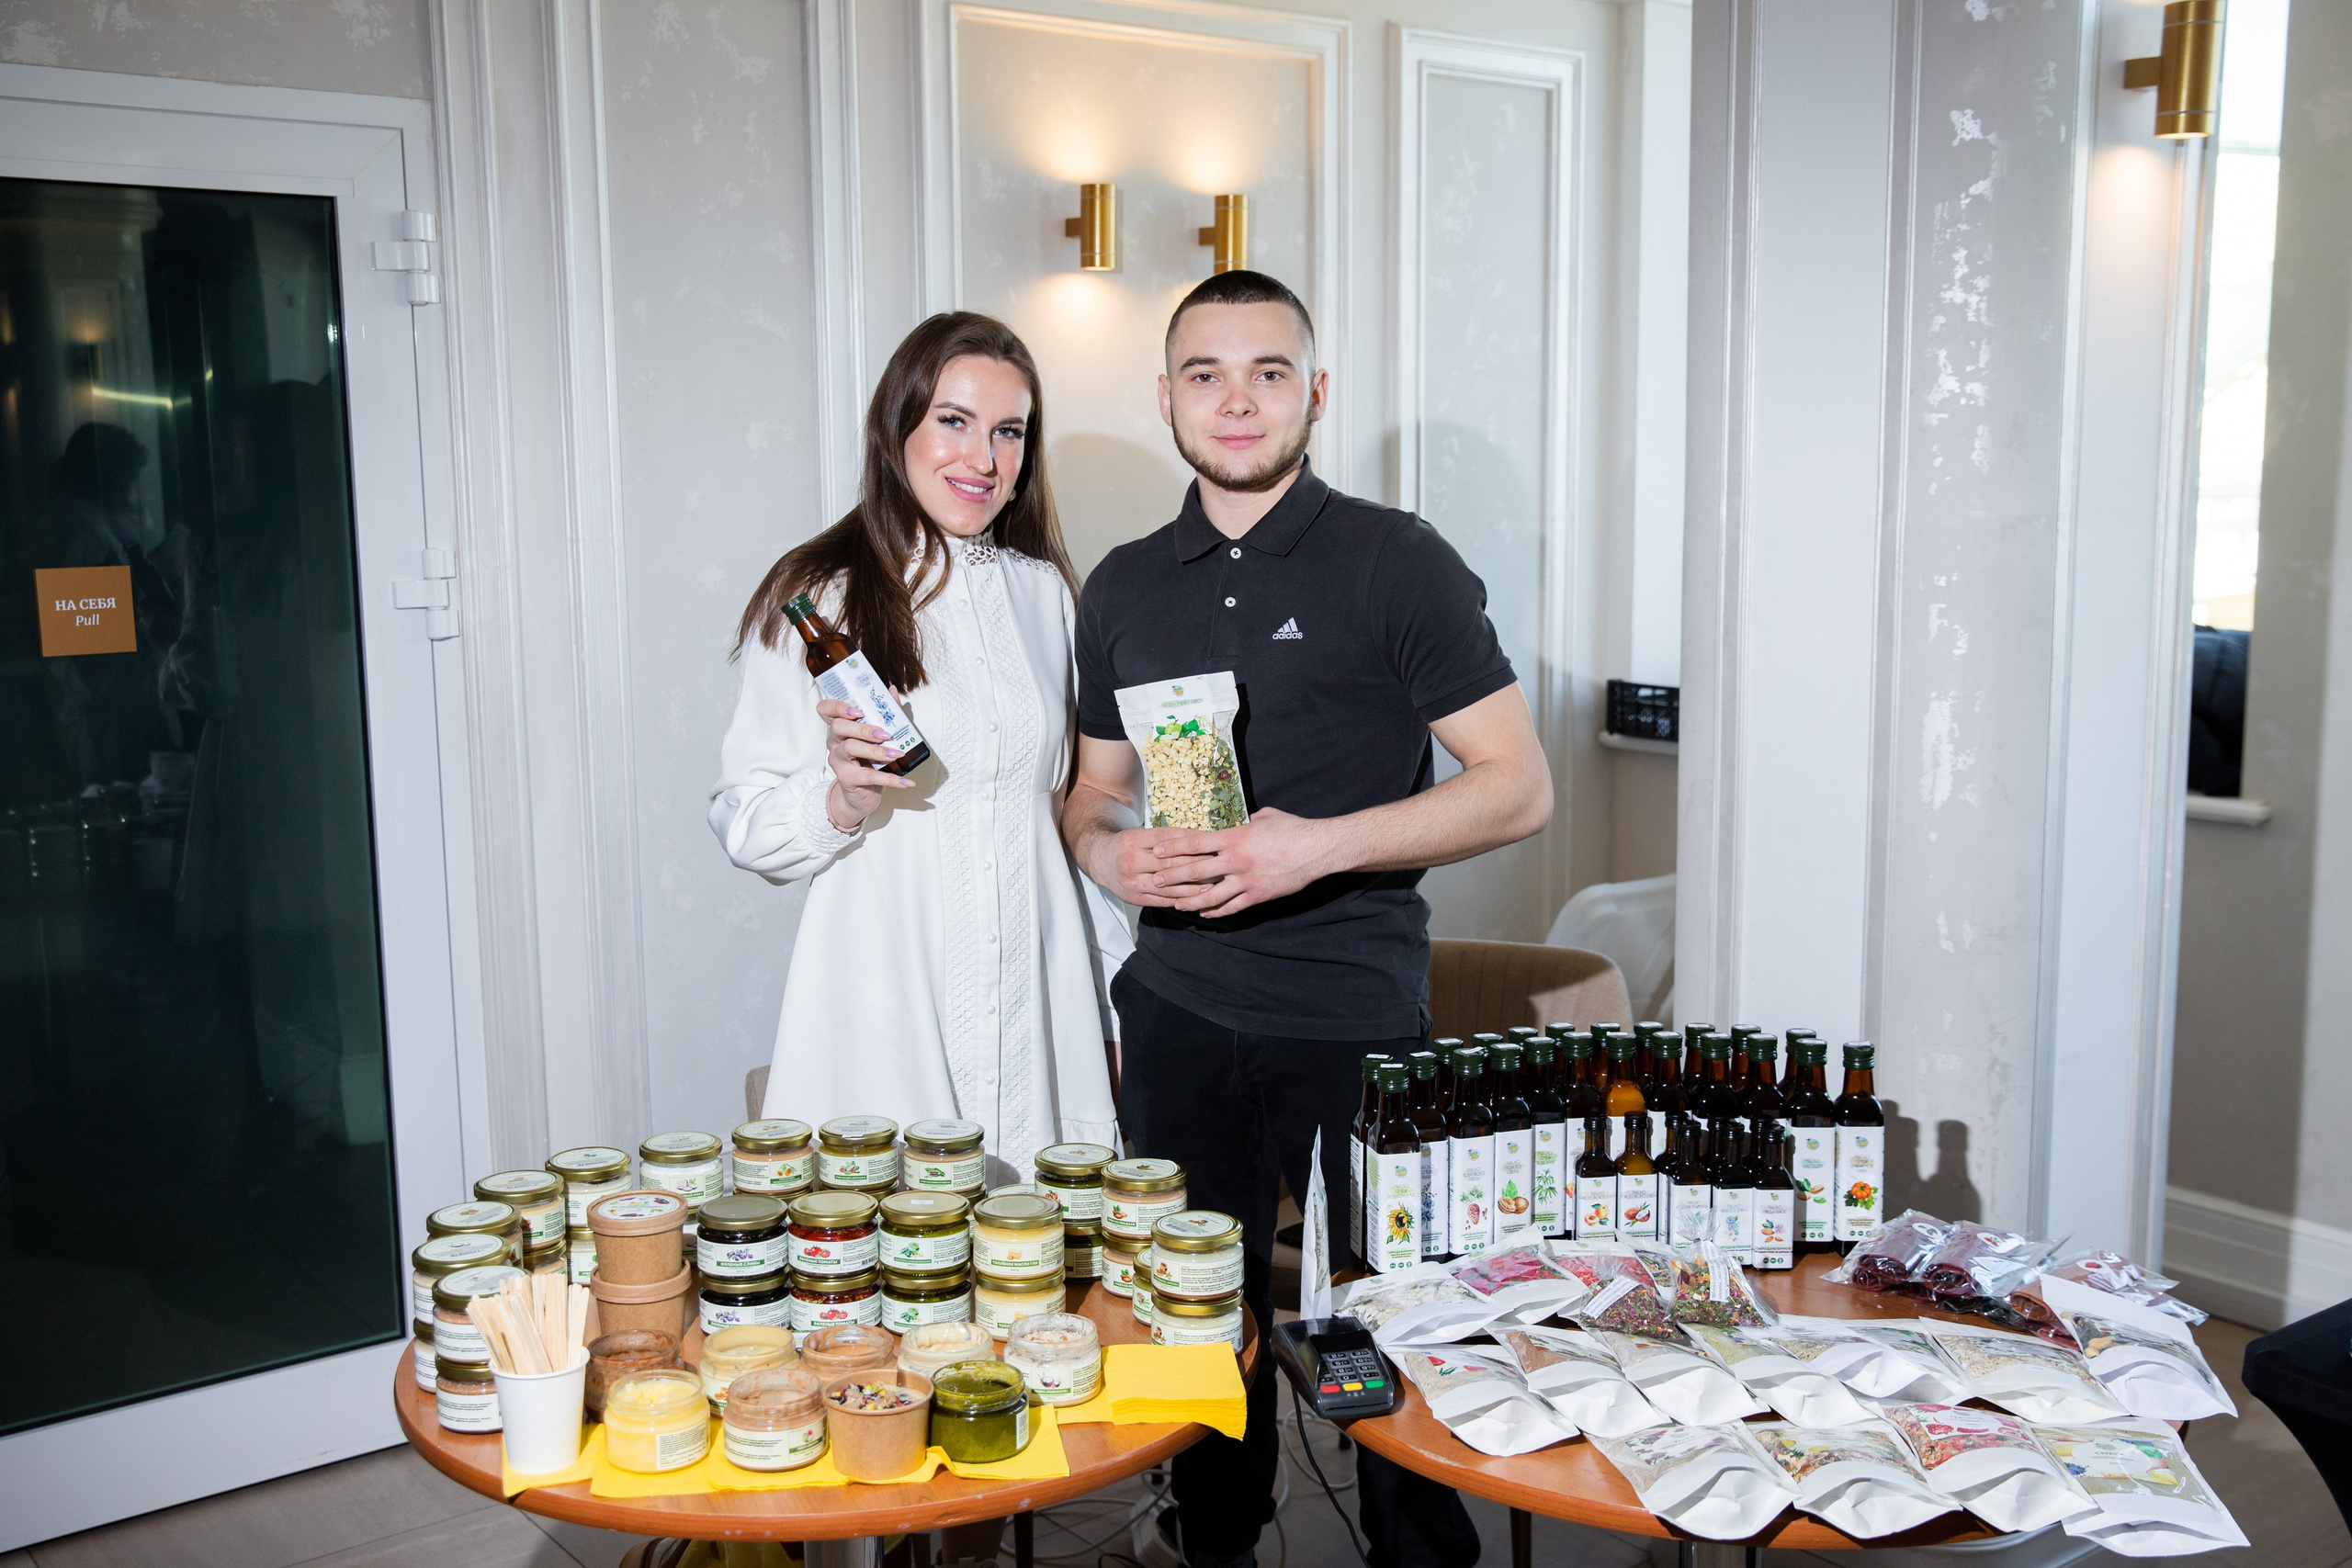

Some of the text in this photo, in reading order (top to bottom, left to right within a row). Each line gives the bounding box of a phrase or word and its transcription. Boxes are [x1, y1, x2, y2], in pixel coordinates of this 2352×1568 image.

[55, 597, 117, 611] НА СЕБЯ
[75, 615, 100, 626] Pull
[1272, 631, 1303, 639] adidas
